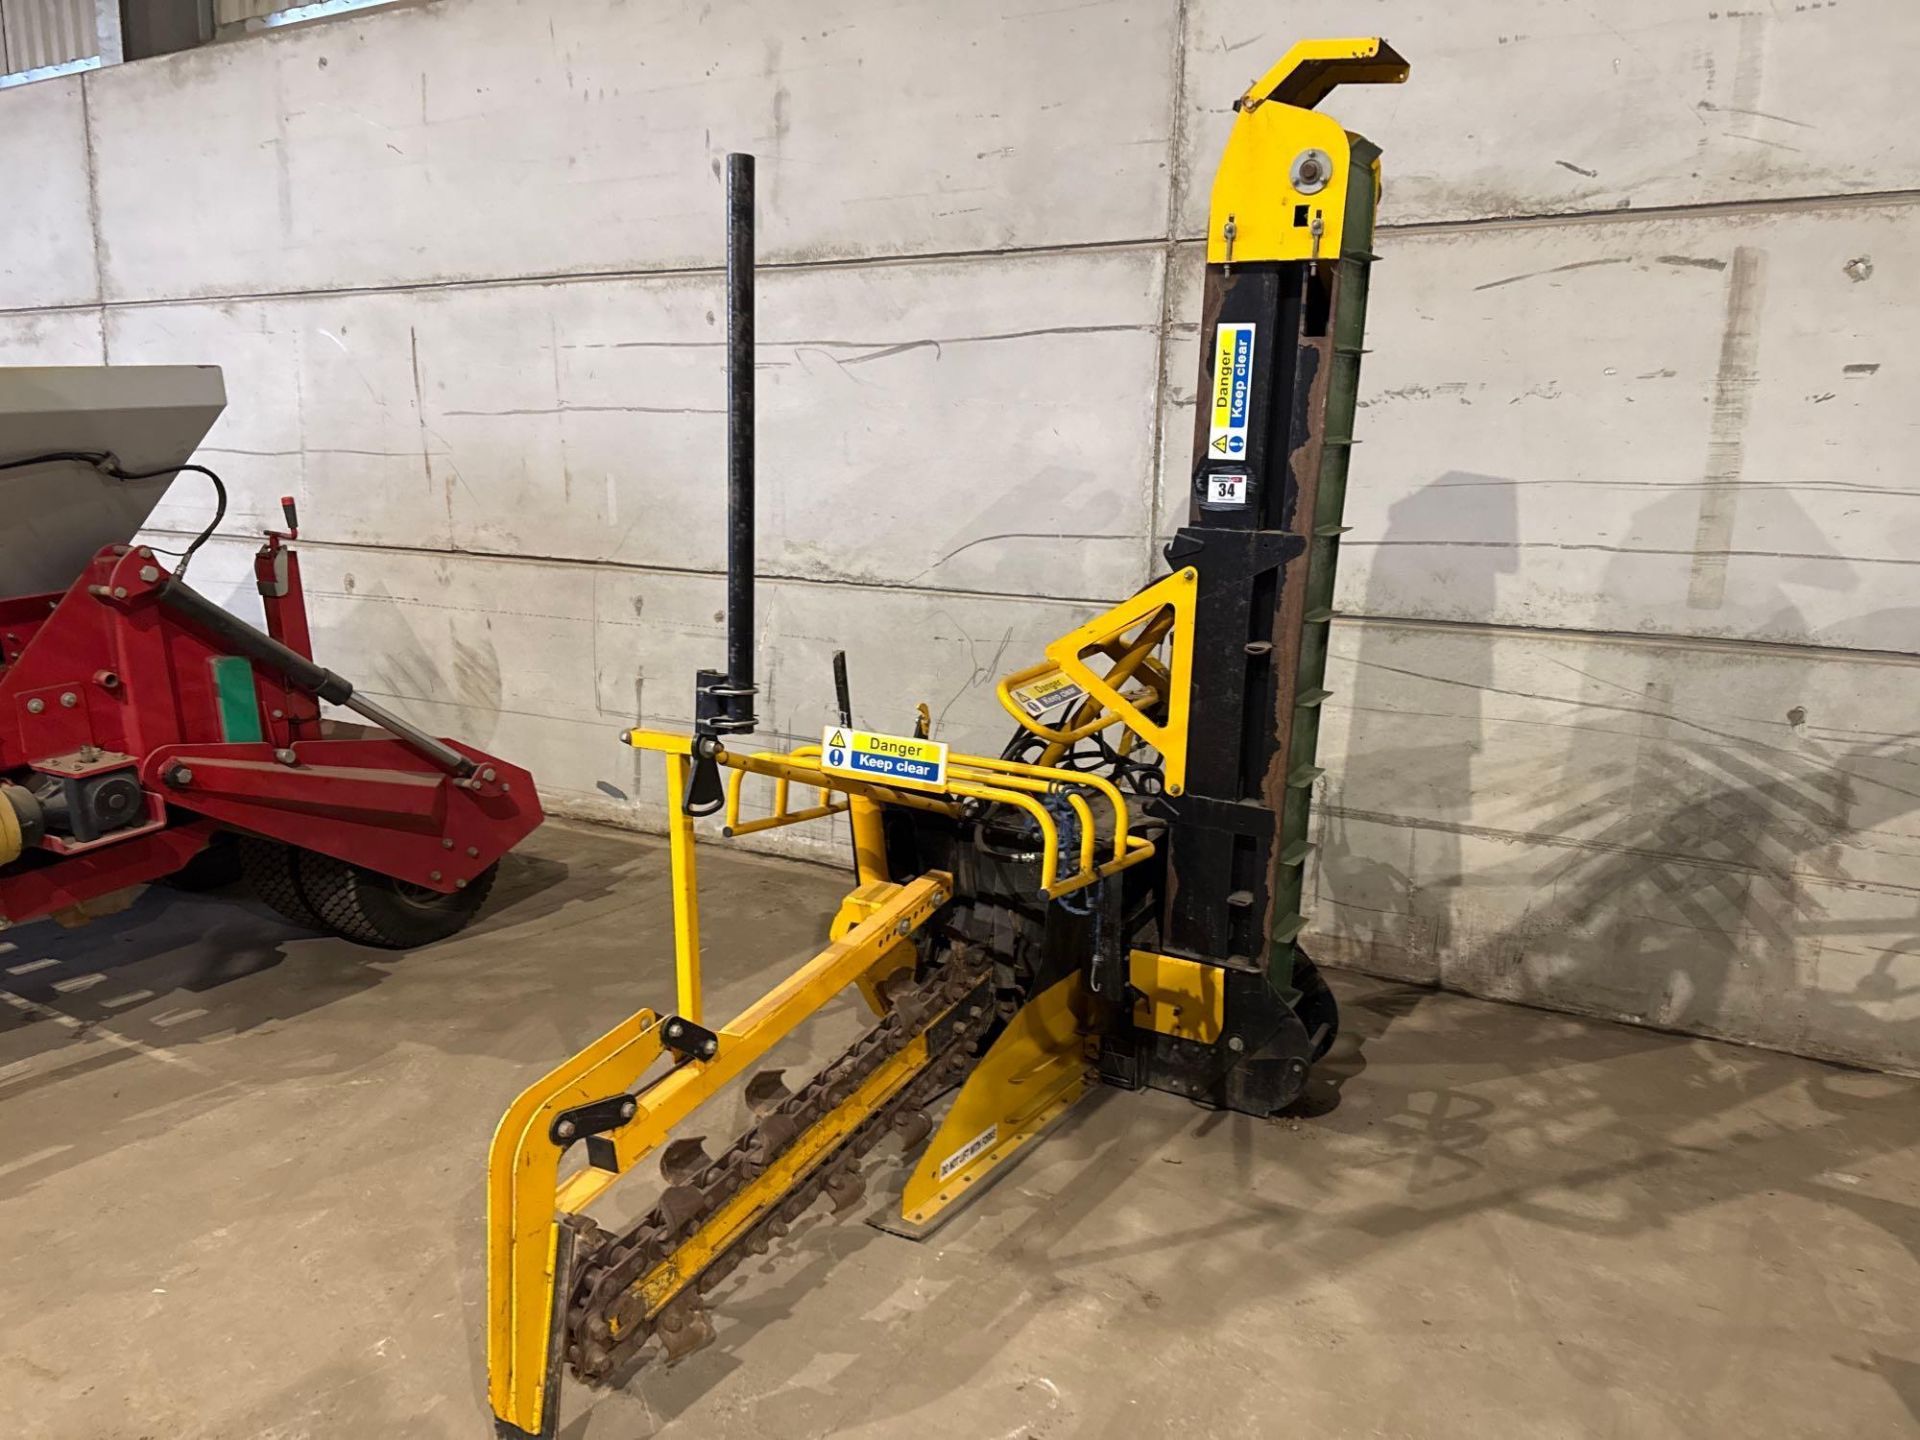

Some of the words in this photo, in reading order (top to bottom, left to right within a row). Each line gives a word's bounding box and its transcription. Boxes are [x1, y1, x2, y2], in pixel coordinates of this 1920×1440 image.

[1235, 339, 1248, 376] clear
[1216, 349, 1232, 408] Danger
[1231, 380, 1247, 418] Keep
[1218, 482, 1235, 497] 34
[1034, 680, 1063, 693] Danger
[1041, 694, 1062, 705] Keep
[1061, 686, 1076, 698] clear
[870, 737, 922, 757] Danger
[859, 754, 893, 772] Keep
[896, 761, 930, 776] clear
